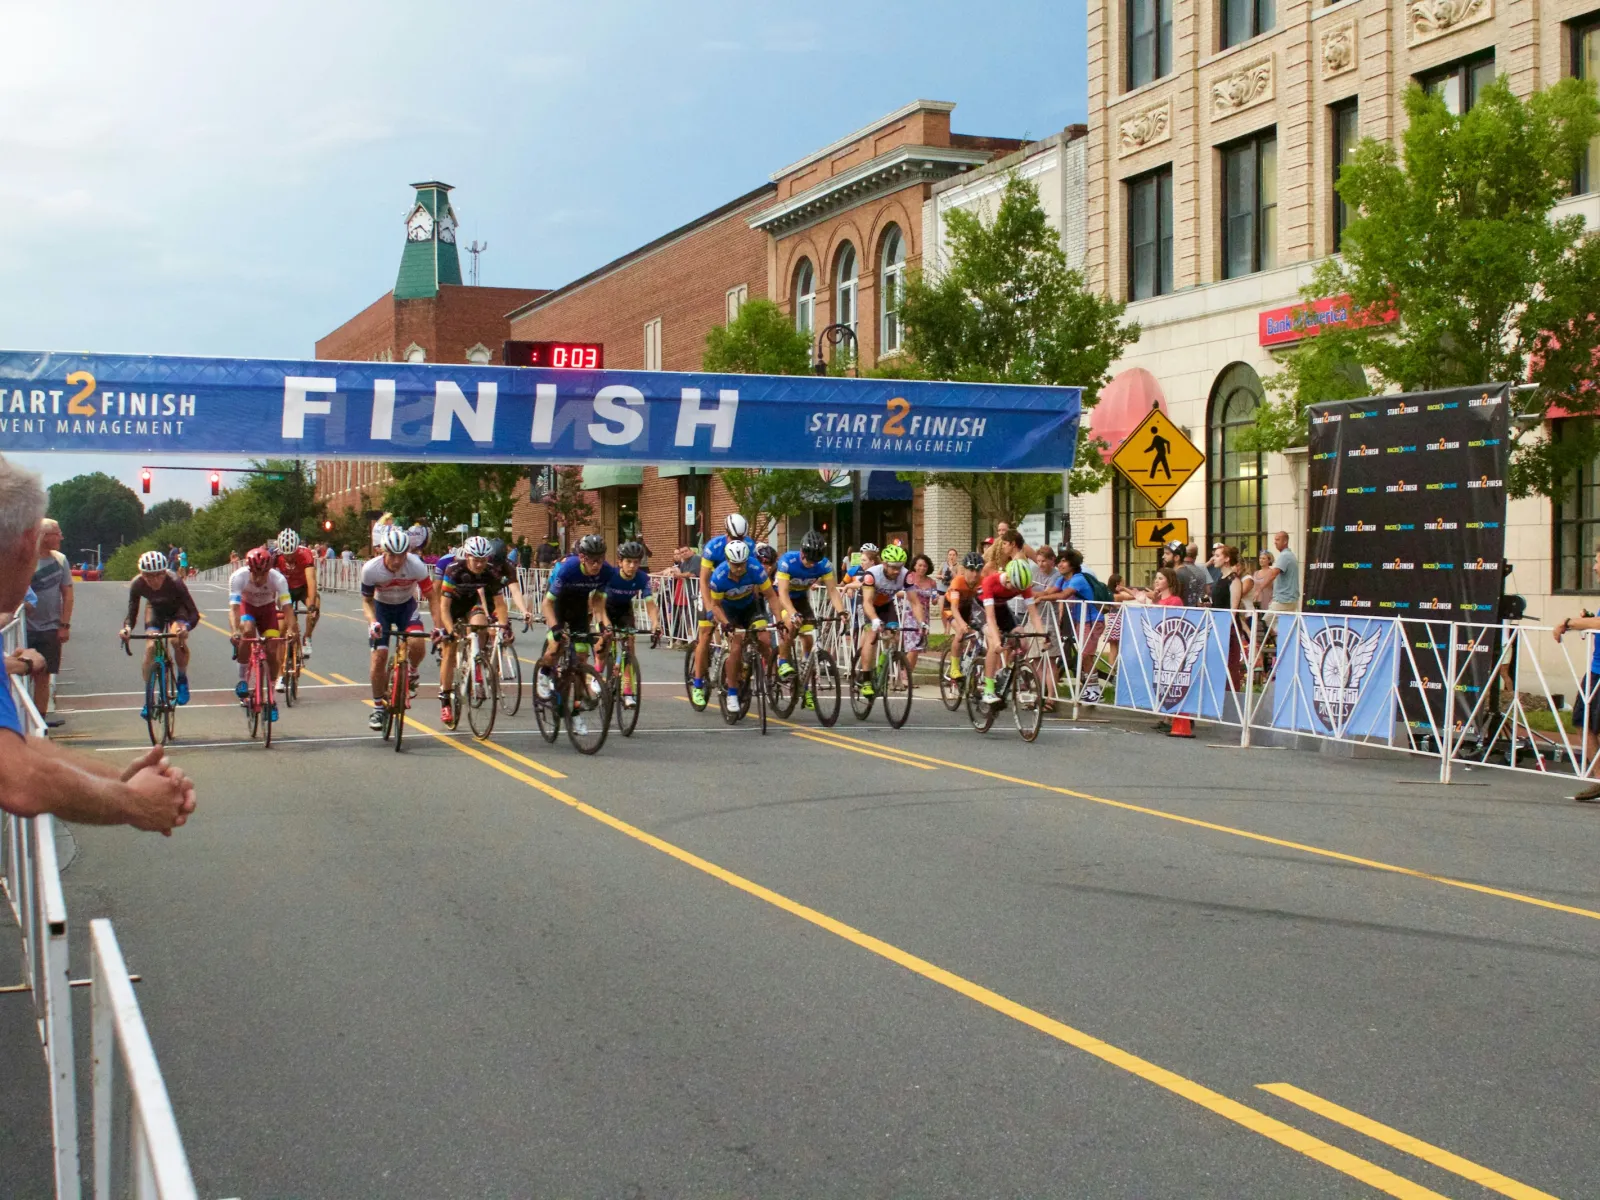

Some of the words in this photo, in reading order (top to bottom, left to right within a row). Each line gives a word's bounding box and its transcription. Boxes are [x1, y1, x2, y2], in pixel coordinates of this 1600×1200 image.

[1267, 313, 1292, 336] Bank
[553, 347, 597, 368] 0:03
[281, 376, 739, 448] FINISH
[57, 419, 184, 435] MANAGEMENT
[816, 436, 864, 449] EVENT
[871, 438, 973, 453] MANAGEMENT
